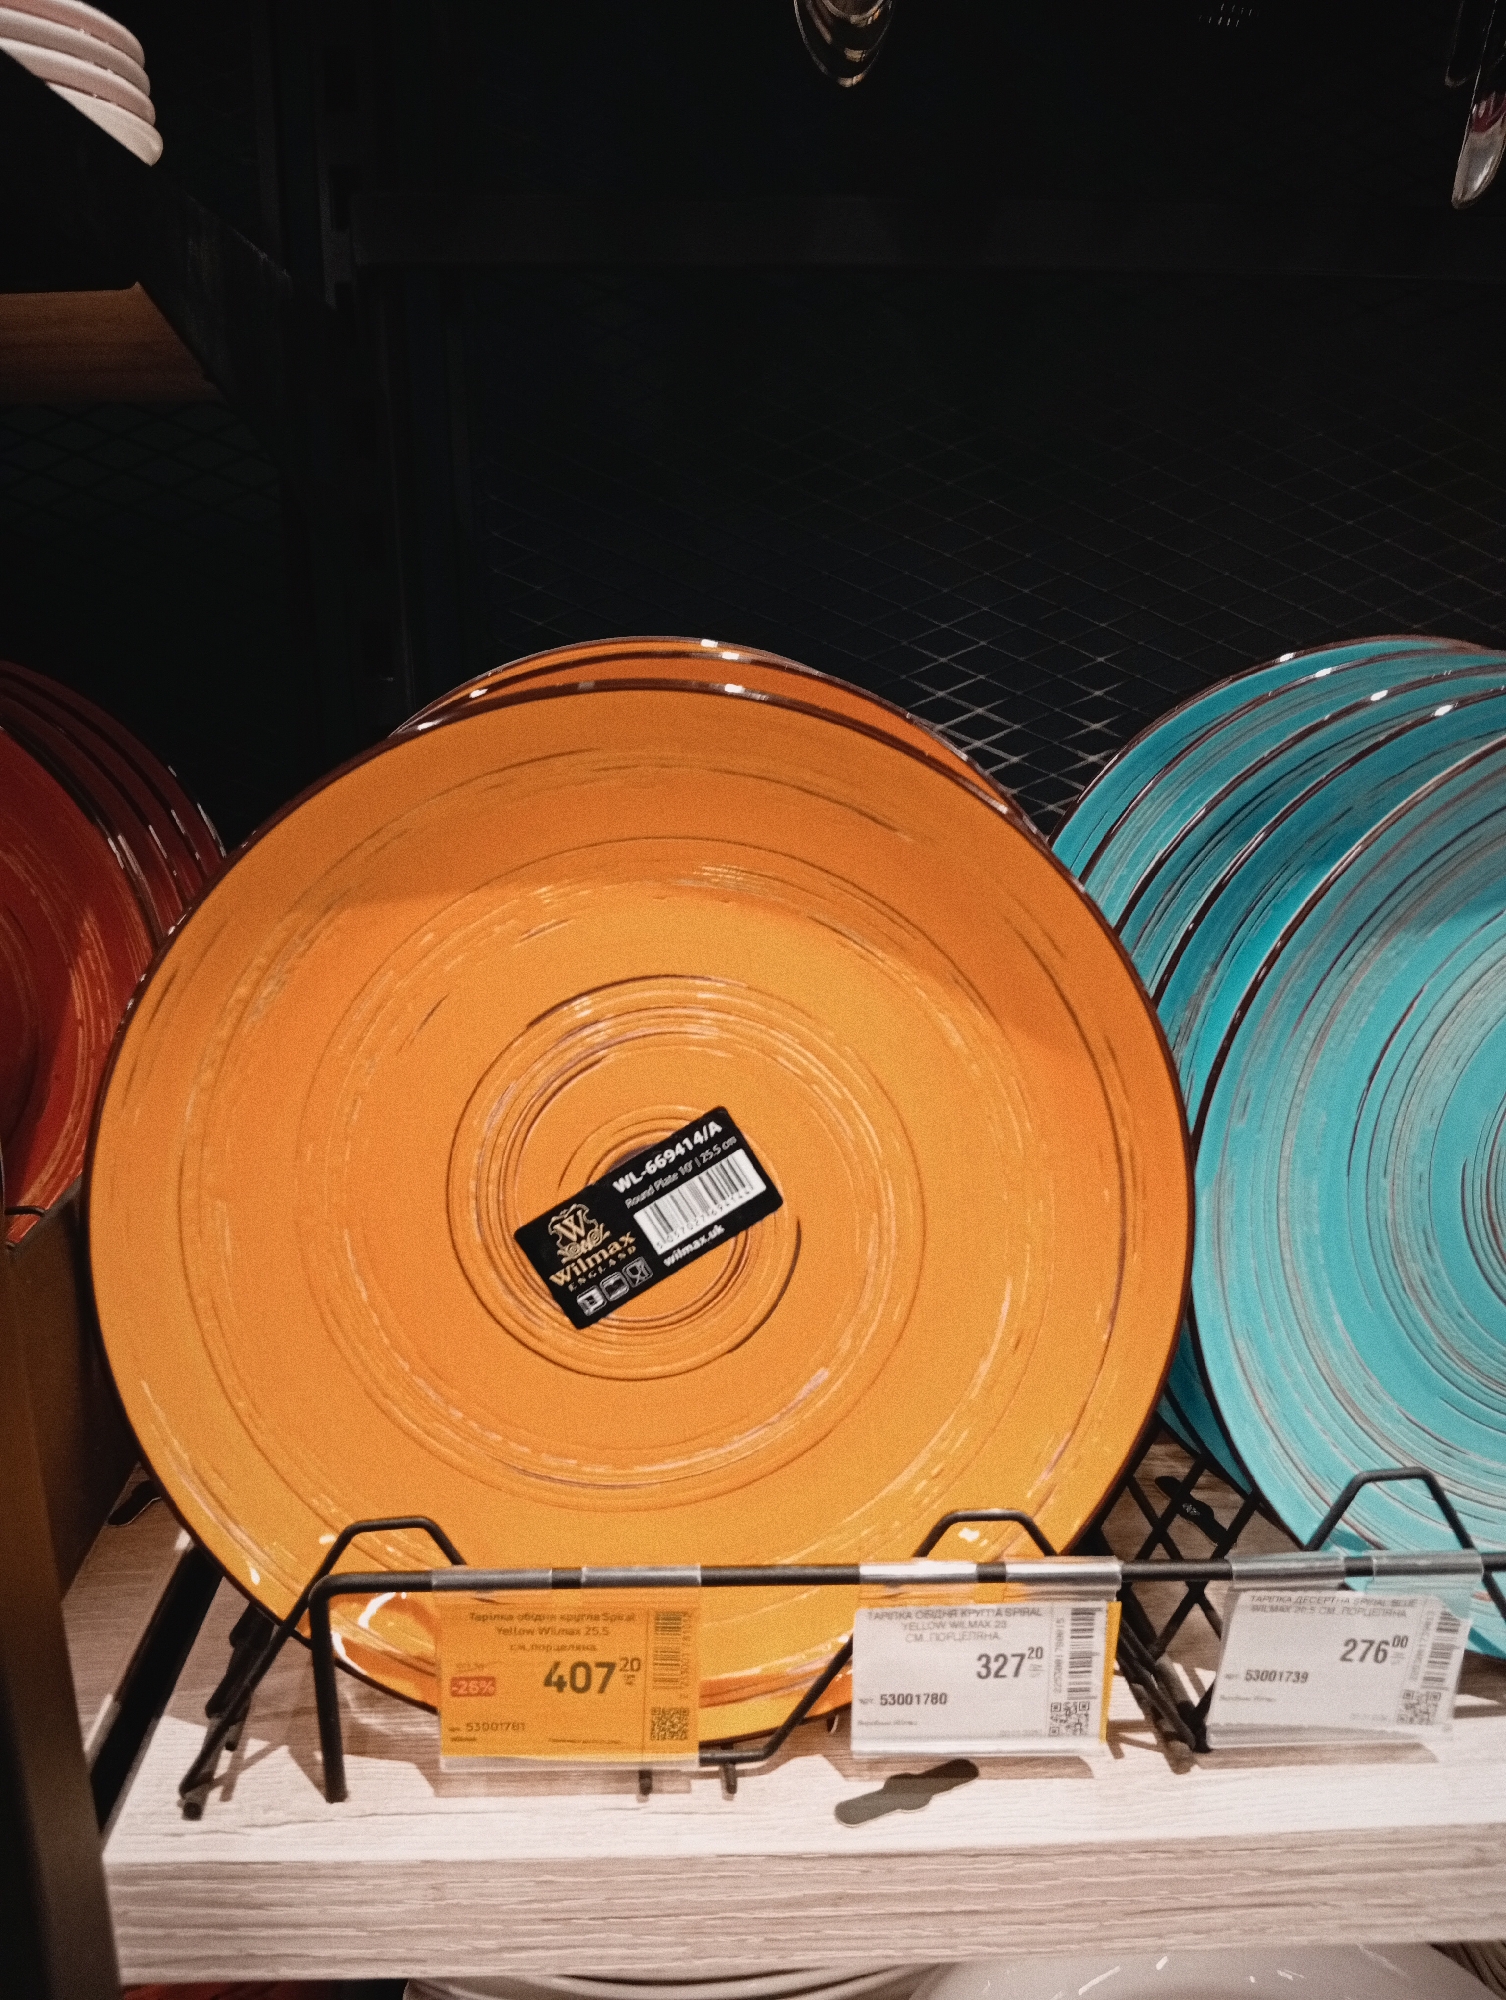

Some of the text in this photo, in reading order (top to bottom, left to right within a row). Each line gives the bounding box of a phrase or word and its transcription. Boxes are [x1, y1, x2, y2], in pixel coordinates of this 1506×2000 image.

[612, 1121, 723, 1194] WL-669414/A
[625, 1184, 655, 1209] Round
[653, 1172, 679, 1191] Plate
[700, 1144, 722, 1163] 25.5
[722, 1135, 738, 1151] cm
[549, 1231, 636, 1287] Wilmax
[663, 1224, 726, 1267] wilmax.uk
[902, 1621, 946, 1631] YELLOW
[950, 1620, 991, 1630] WILMAX
[1004, 1606, 1043, 1617] SPIRAL
[497, 1626, 535, 1636] Yellow
[538, 1626, 581, 1636] Wilmax
[976, 1653, 1027, 1680] 327
[1028, 1646, 1044, 1660] 20
[1340, 1639, 1390, 1664] 276
[1392, 1635, 1409, 1649] 00
[543, 1661, 617, 1694] 407
[619, 1657, 642, 1672] 20
[1244, 1669, 1309, 1684] 53001739
[879, 1692, 948, 1706] 53001780
[466, 1722, 526, 1732] 53001781
